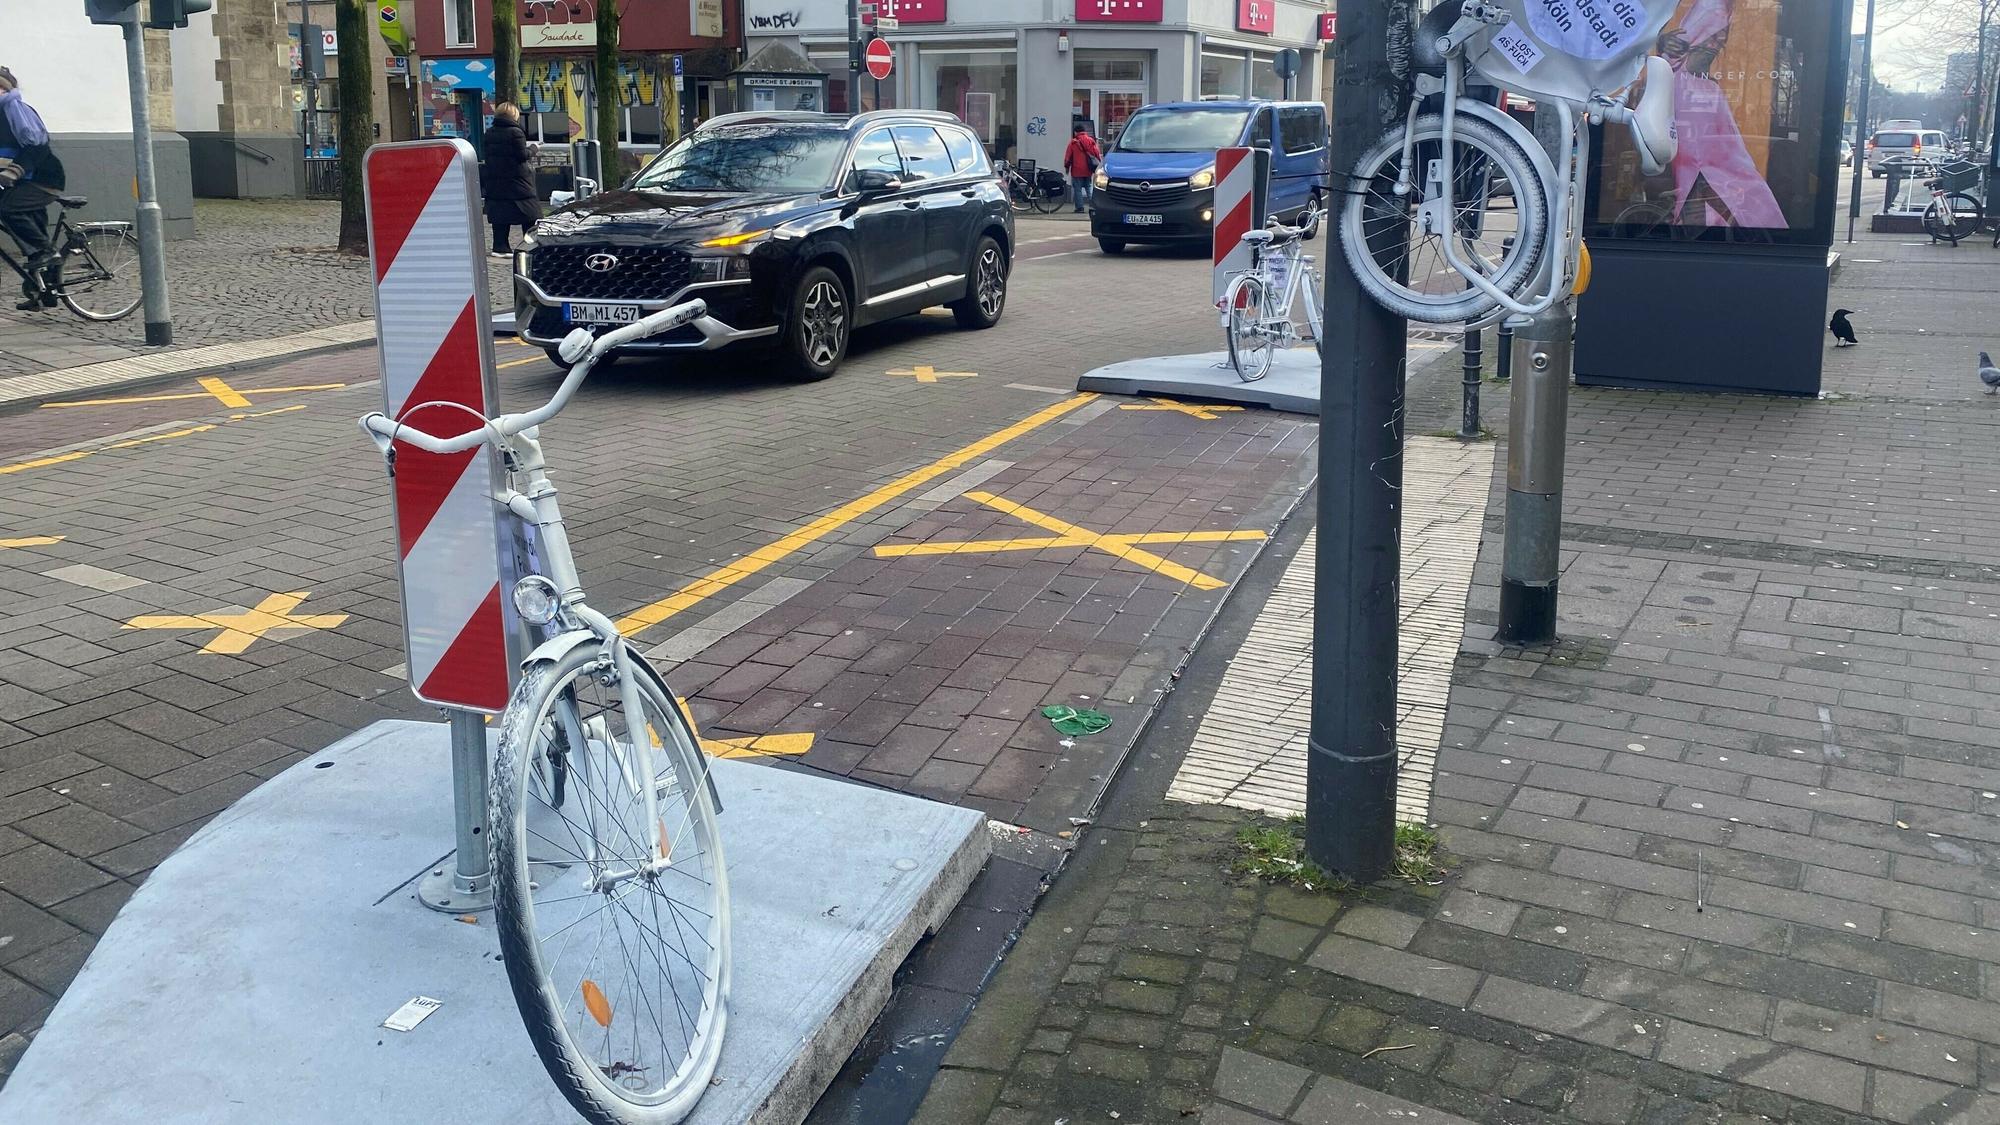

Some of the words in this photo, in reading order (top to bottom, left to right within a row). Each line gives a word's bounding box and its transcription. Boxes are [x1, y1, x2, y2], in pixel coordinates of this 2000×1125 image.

[1575, 0, 1619, 48] dstadt
[1613, 2, 1636, 28] die
[536, 26, 584, 45] Saudade
[1498, 37, 1511, 48] AS
[1515, 39, 1536, 59] LOST
[1680, 71, 1795, 80] NINGER.COM
[571, 306, 588, 320] BM
[594, 307, 611, 320] MI
[613, 307, 637, 321] 457
